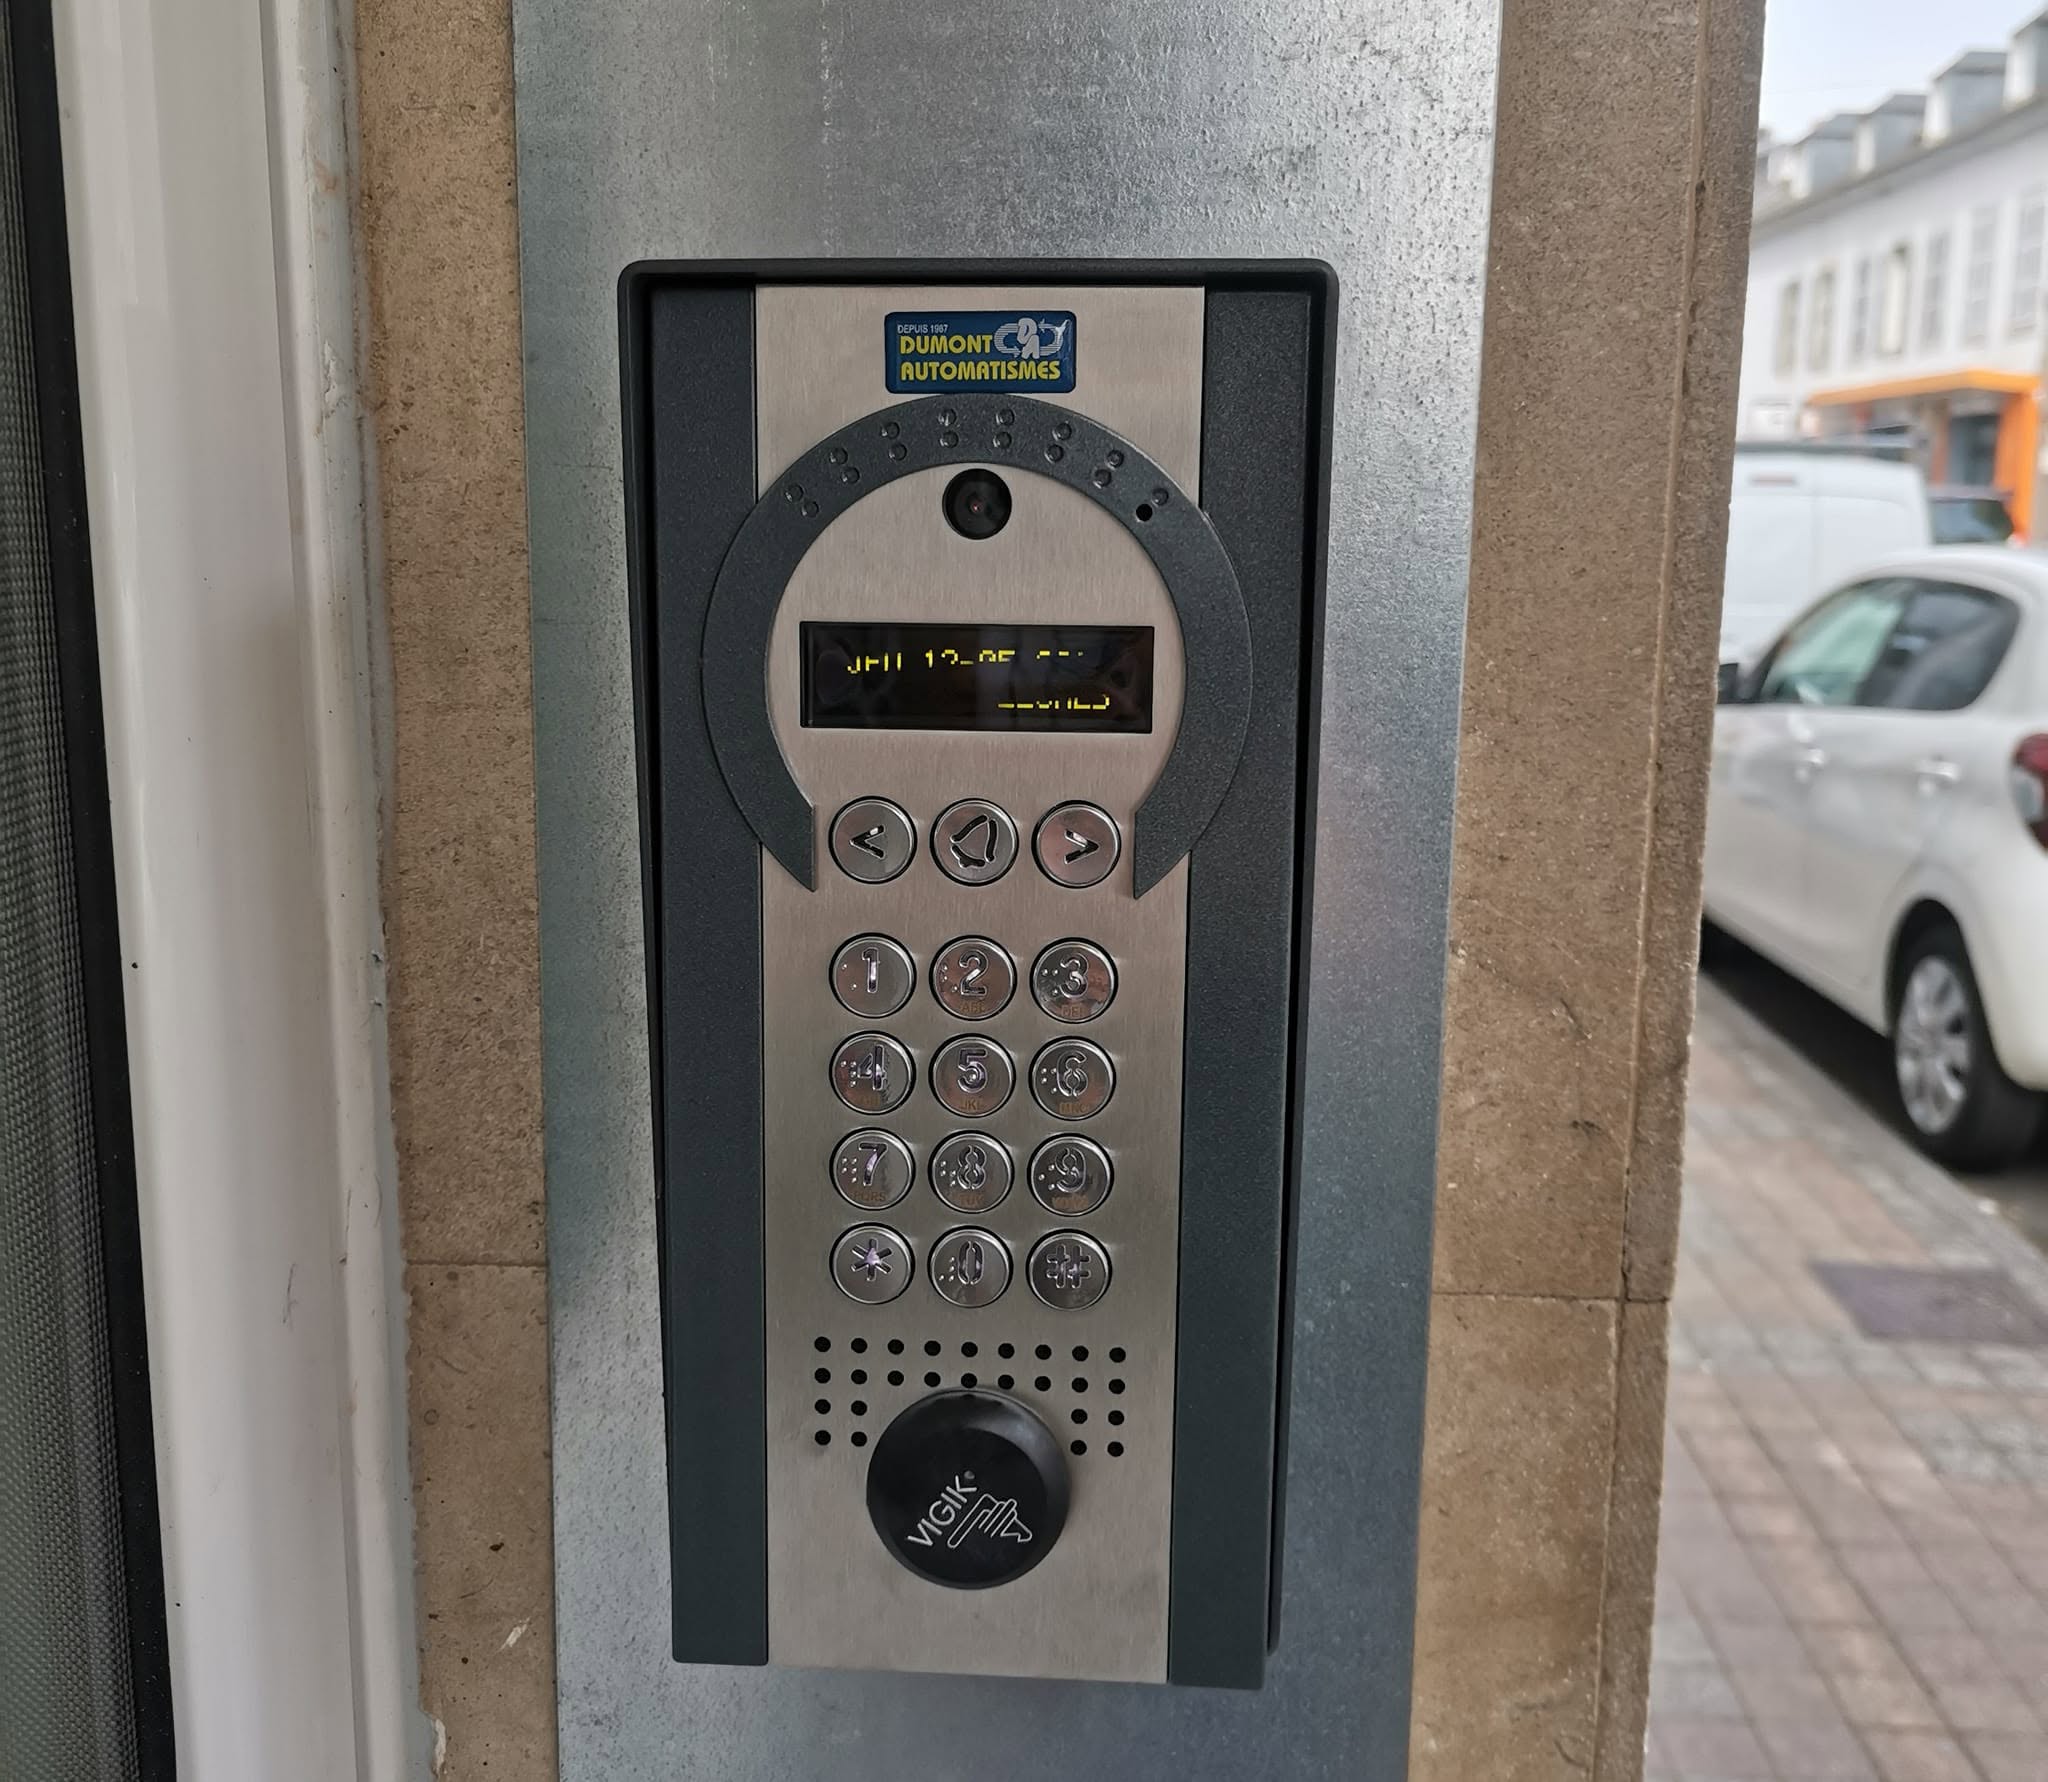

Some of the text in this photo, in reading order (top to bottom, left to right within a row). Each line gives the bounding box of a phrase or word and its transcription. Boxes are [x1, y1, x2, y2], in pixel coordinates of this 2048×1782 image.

[897, 324, 928, 334] DEPUIS
[900, 335, 993, 354] DUMONT
[901, 361, 1061, 381] AUTOMATISMES
[861, 948, 880, 993] 1
[959, 950, 989, 996] 2
[1059, 952, 1088, 999] 3
[856, 1044, 887, 1091] 4
[957, 1048, 988, 1094] 5
[1056, 1051, 1088, 1097] 6
[858, 1143, 888, 1187] 7
[956, 1144, 987, 1190] 8
[1054, 1148, 1087, 1193] 9
[958, 1240, 985, 1285] 0
[907, 1475, 977, 1546] VIGIK
